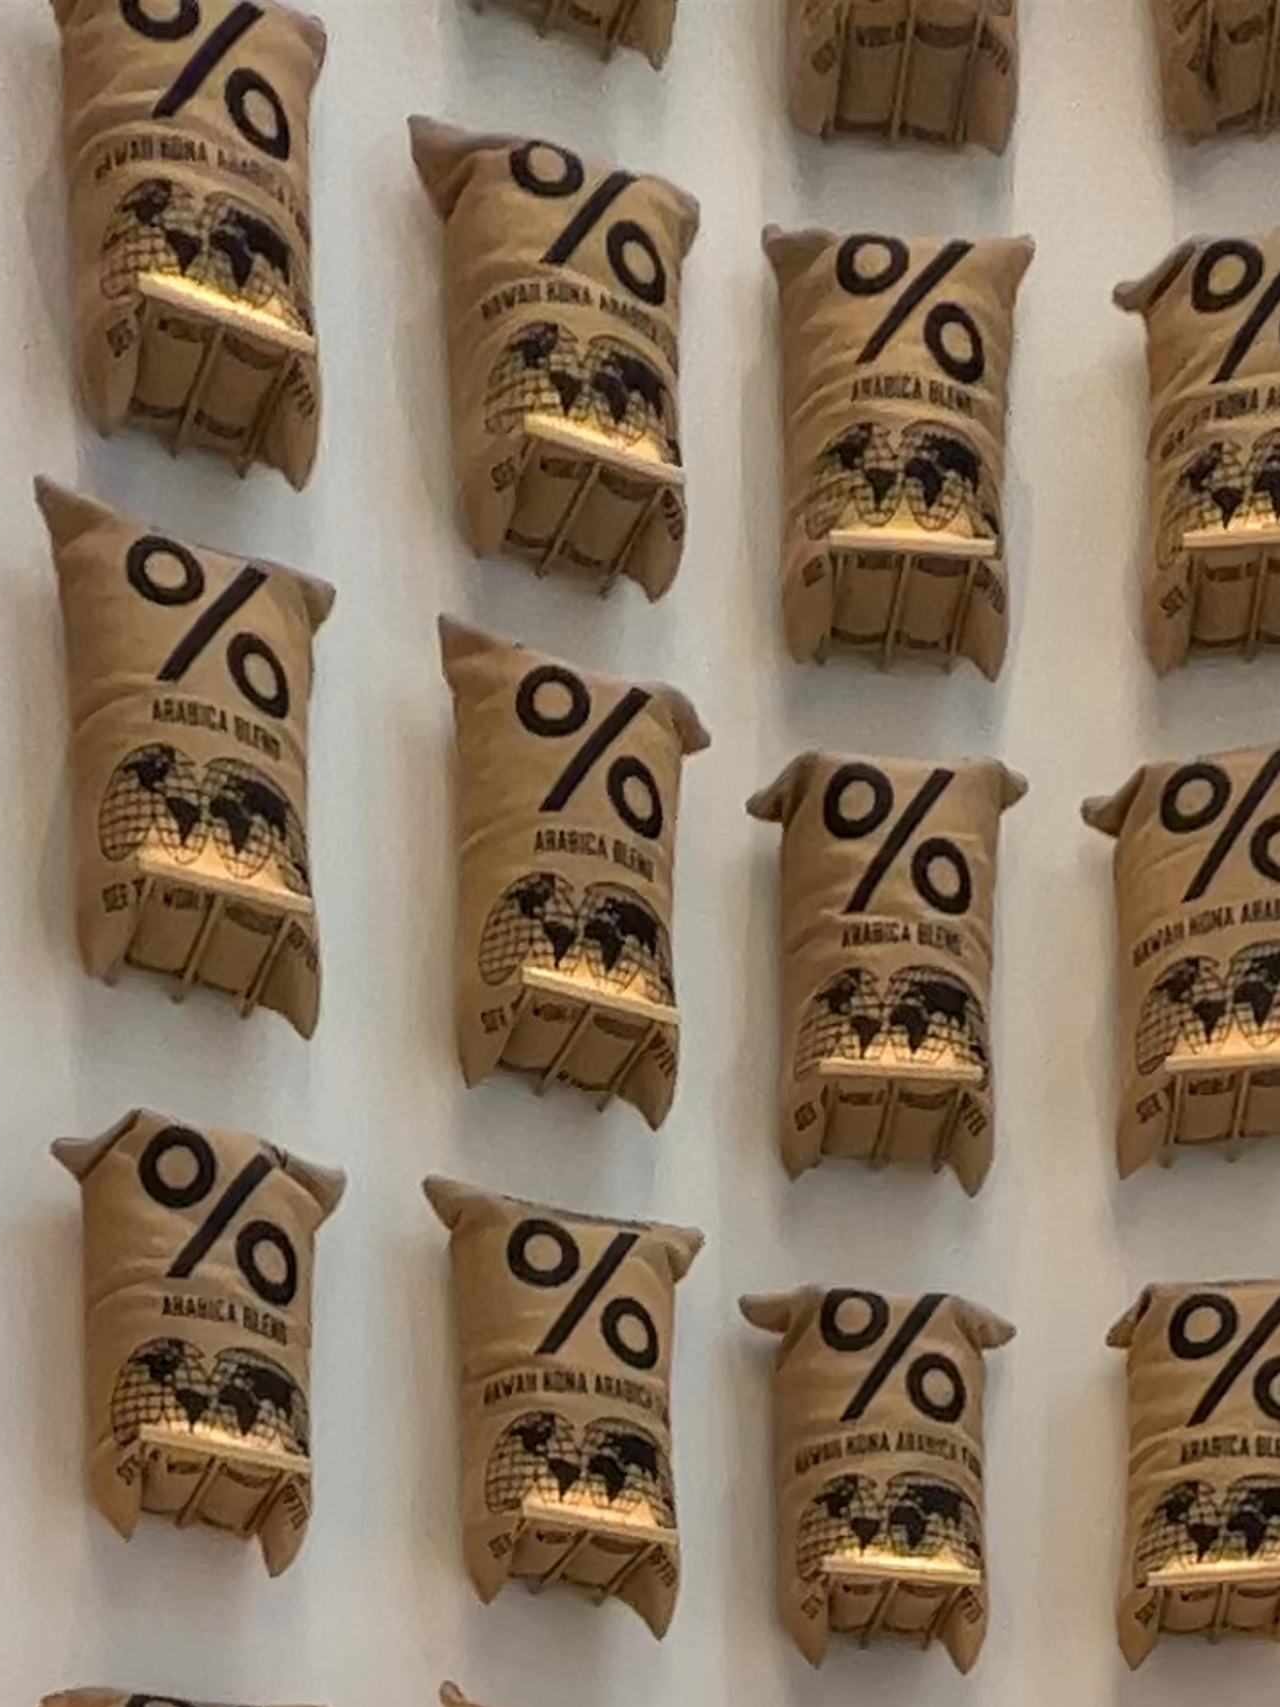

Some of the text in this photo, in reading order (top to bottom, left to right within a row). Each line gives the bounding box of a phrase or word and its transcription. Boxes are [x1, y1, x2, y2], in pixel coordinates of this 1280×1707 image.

[153, 699, 227, 733] ARABICA
[534, 830, 608, 859] ARABICA
[842, 922, 910, 949] ARABICA
[162, 1296, 236, 1323] ARABICA
[595, 1376, 653, 1409] ARABICA
[896, 1431, 957, 1460] ARABICA
[1180, 1435, 1250, 1465] ARABICA
